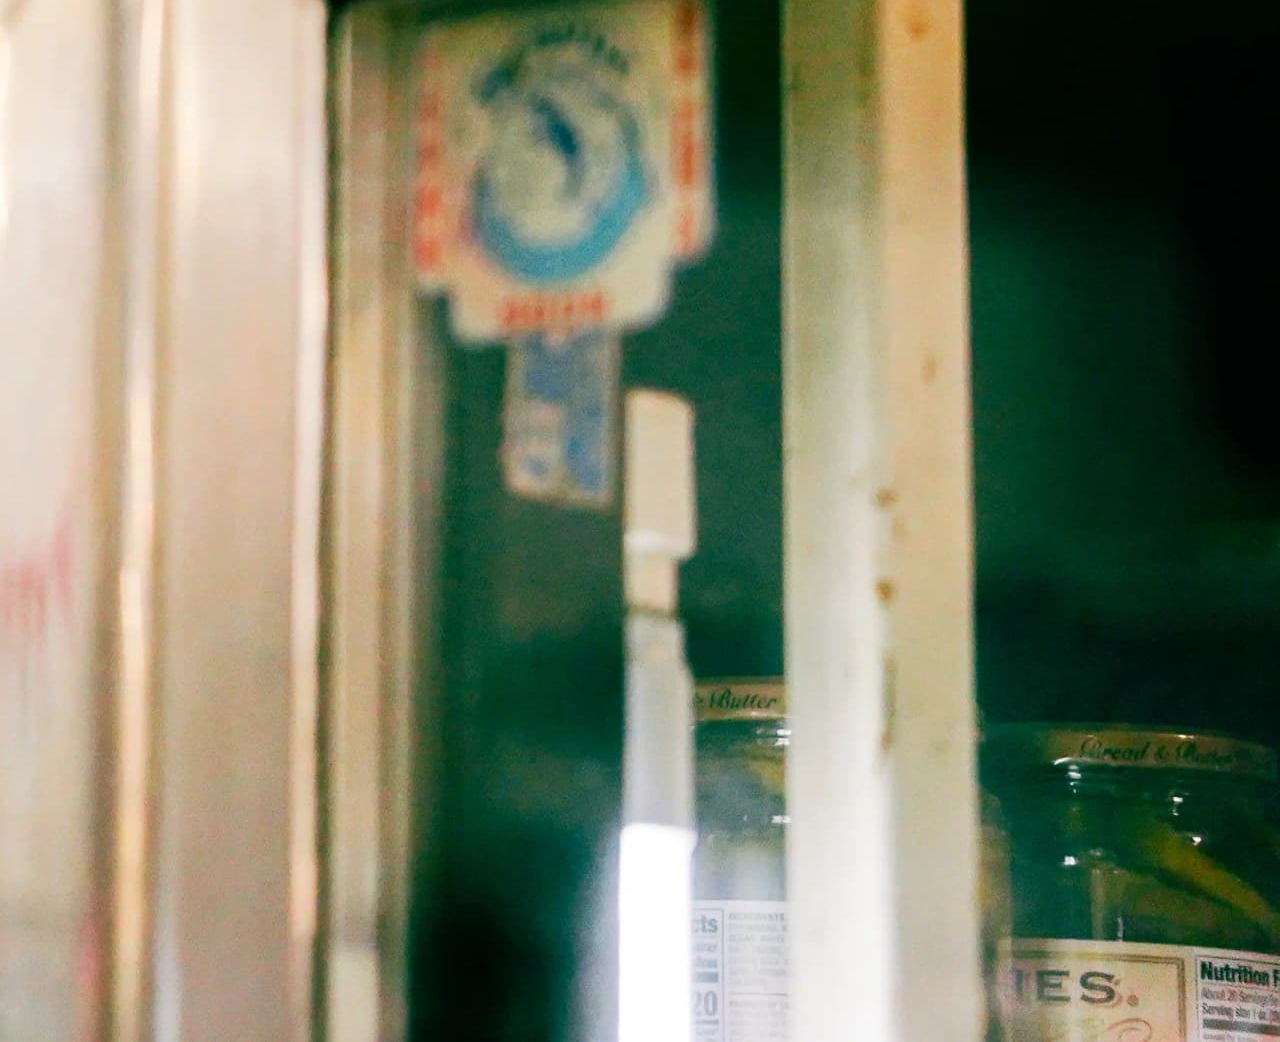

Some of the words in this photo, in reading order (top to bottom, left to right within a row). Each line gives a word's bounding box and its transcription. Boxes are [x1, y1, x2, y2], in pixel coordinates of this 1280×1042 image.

[708, 685, 777, 710] Butter
[1079, 736, 1150, 760] Bread
[1201, 961, 1269, 986] Nutrition
